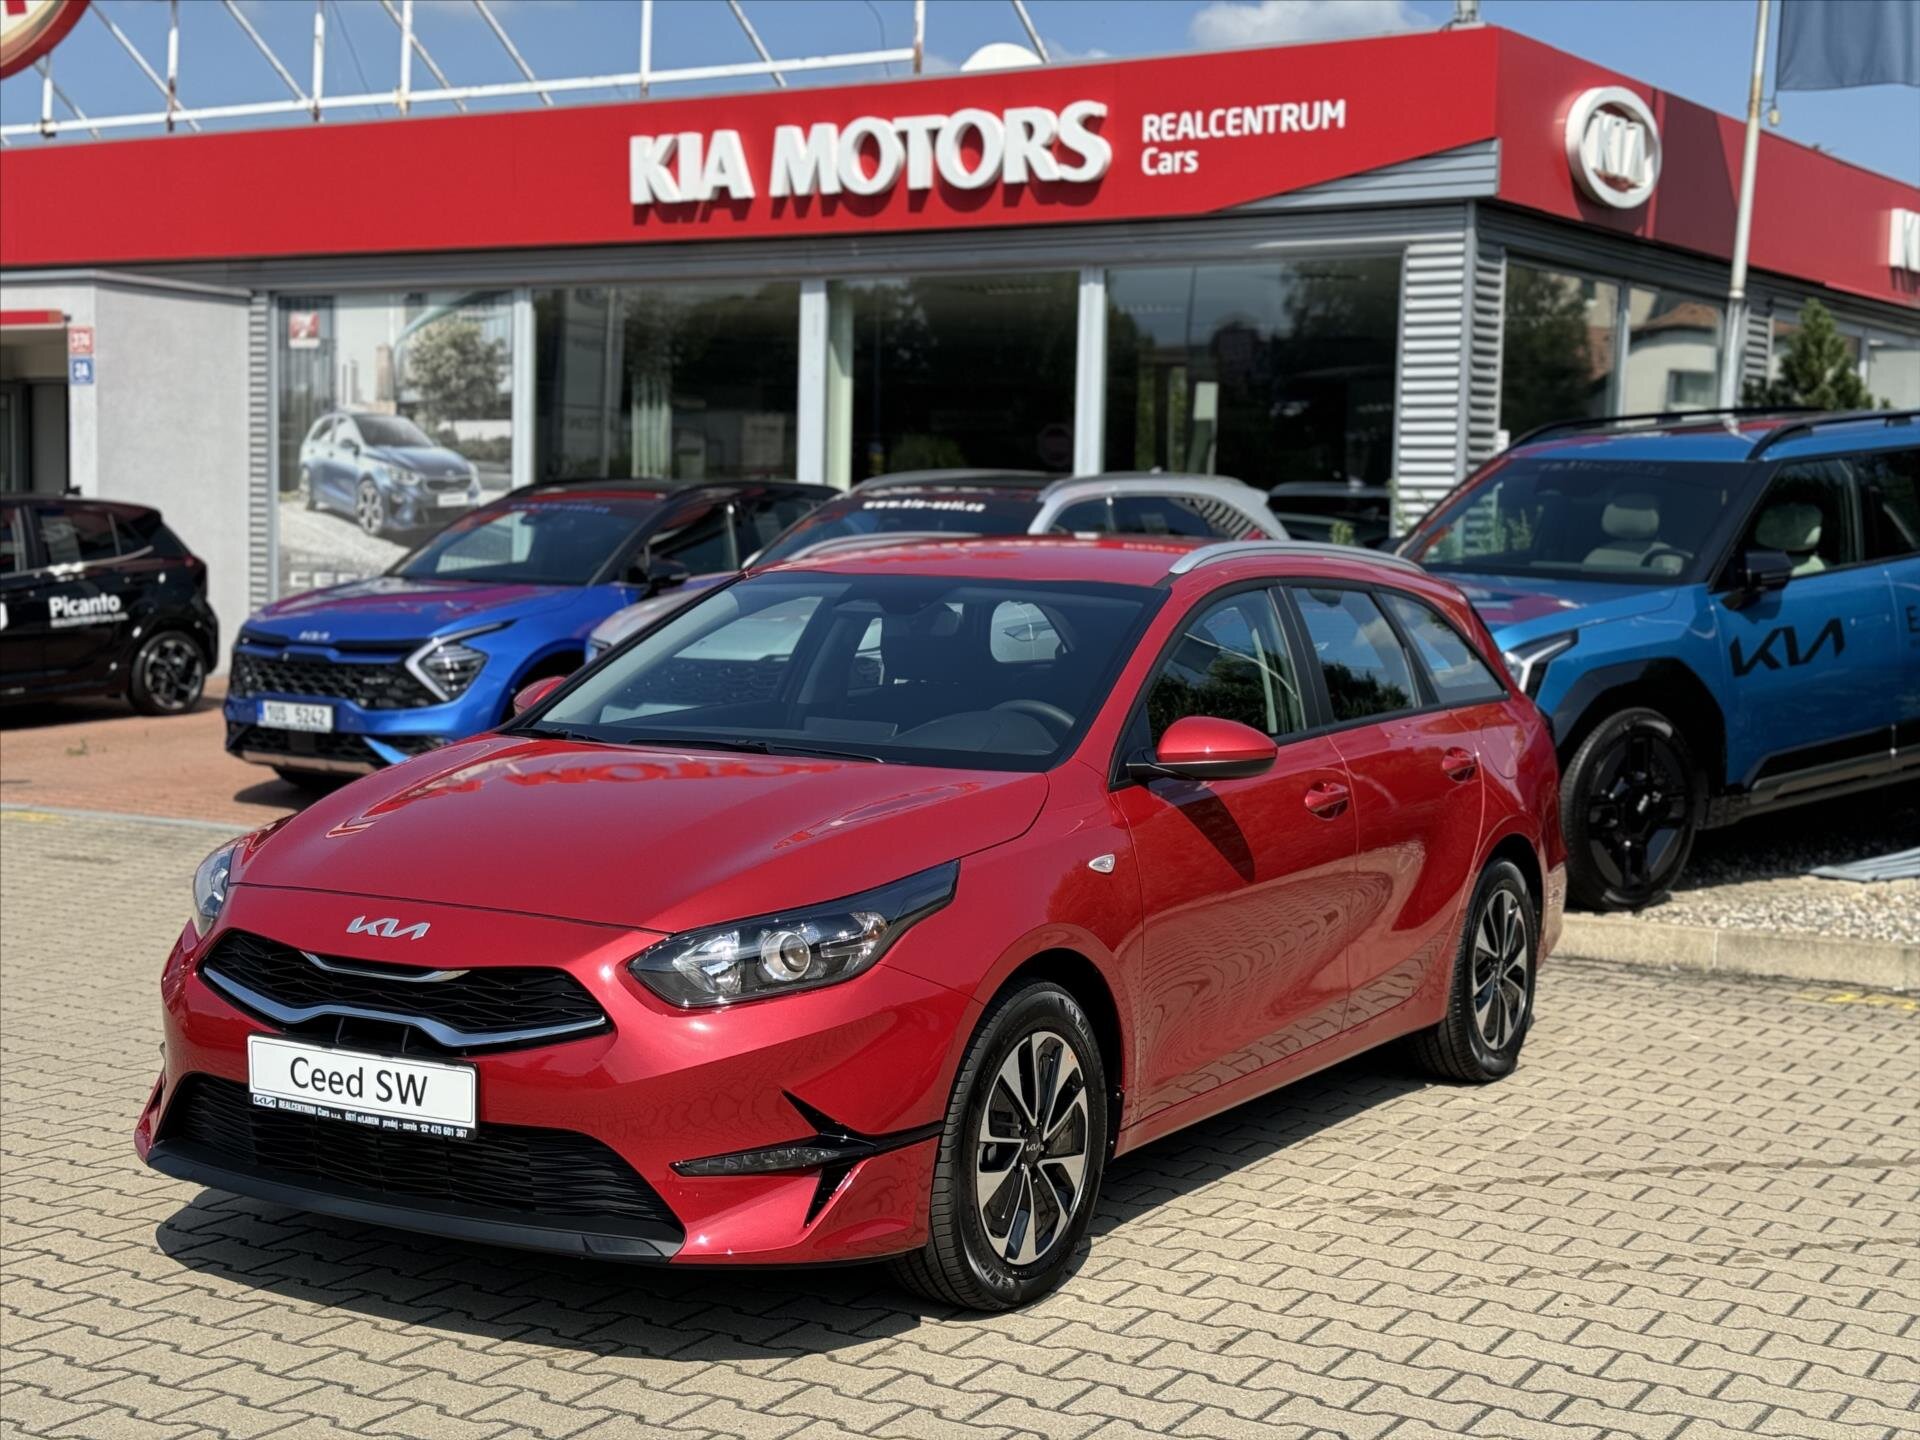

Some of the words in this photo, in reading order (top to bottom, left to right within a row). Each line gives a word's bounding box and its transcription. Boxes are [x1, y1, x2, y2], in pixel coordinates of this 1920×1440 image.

[1142, 99, 1346, 143] REALCENTRUM
[629, 129, 756, 205] KIA
[769, 100, 1112, 200] MOTORS
[1141, 147, 1199, 176] Cars
[49, 592, 121, 618] Picanto
[1729, 616, 1846, 677] KIA
[346, 916, 431, 940] KIA
[290, 1057, 363, 1098] Ceed
[376, 1070, 427, 1106] SW
[278, 1100, 316, 1114] REALCENTRUM
